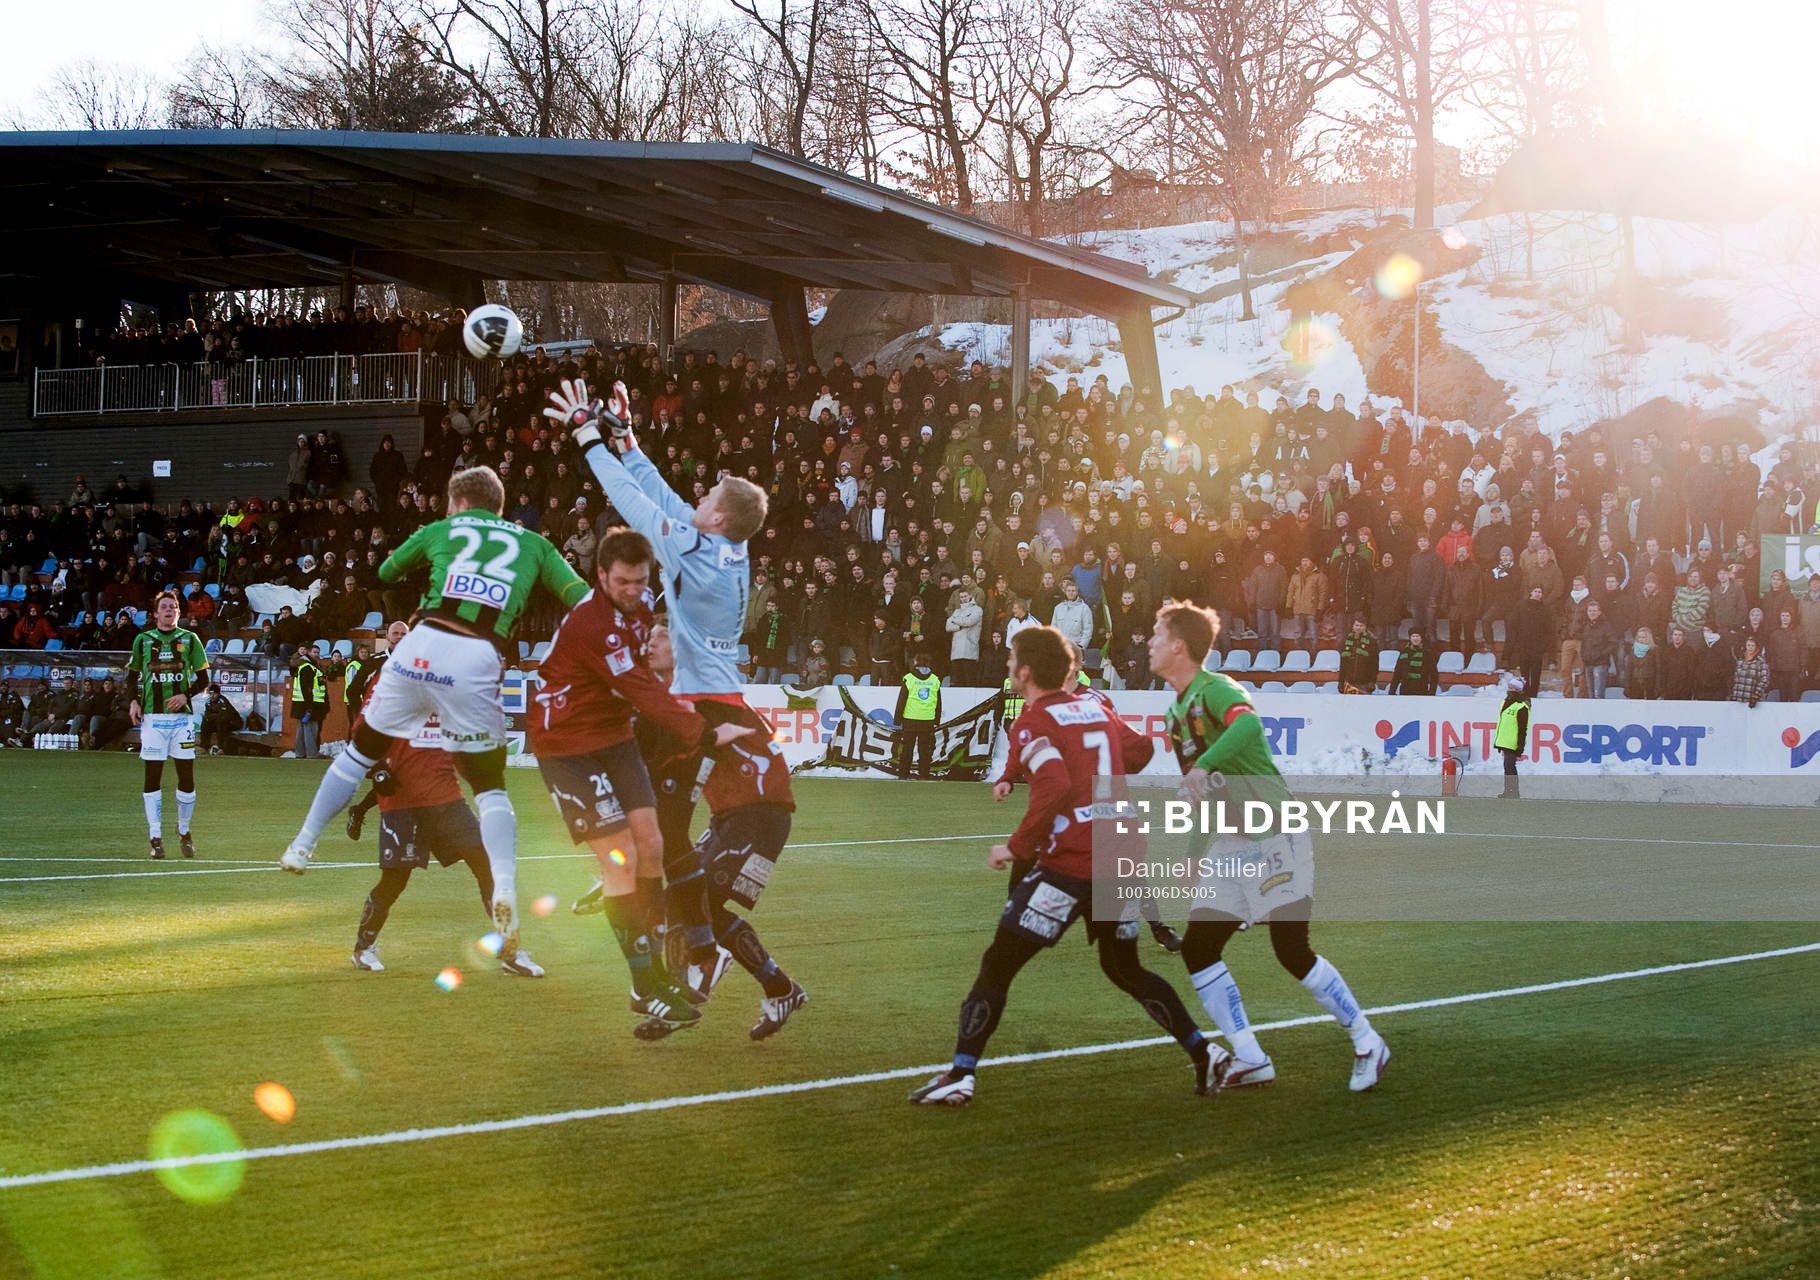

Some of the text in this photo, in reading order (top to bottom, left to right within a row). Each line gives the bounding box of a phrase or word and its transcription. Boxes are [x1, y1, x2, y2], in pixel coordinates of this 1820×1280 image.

[447, 526, 519, 584] 22
[454, 575, 507, 602] BDO
[150, 672, 184, 683] ABRO
[392, 661, 455, 687] Stena Bulk
[1428, 719, 1706, 767] INTRSPORT
[1083, 731, 1112, 799] 7
[589, 772, 613, 797] 26
[1267, 852, 1284, 873] 15
